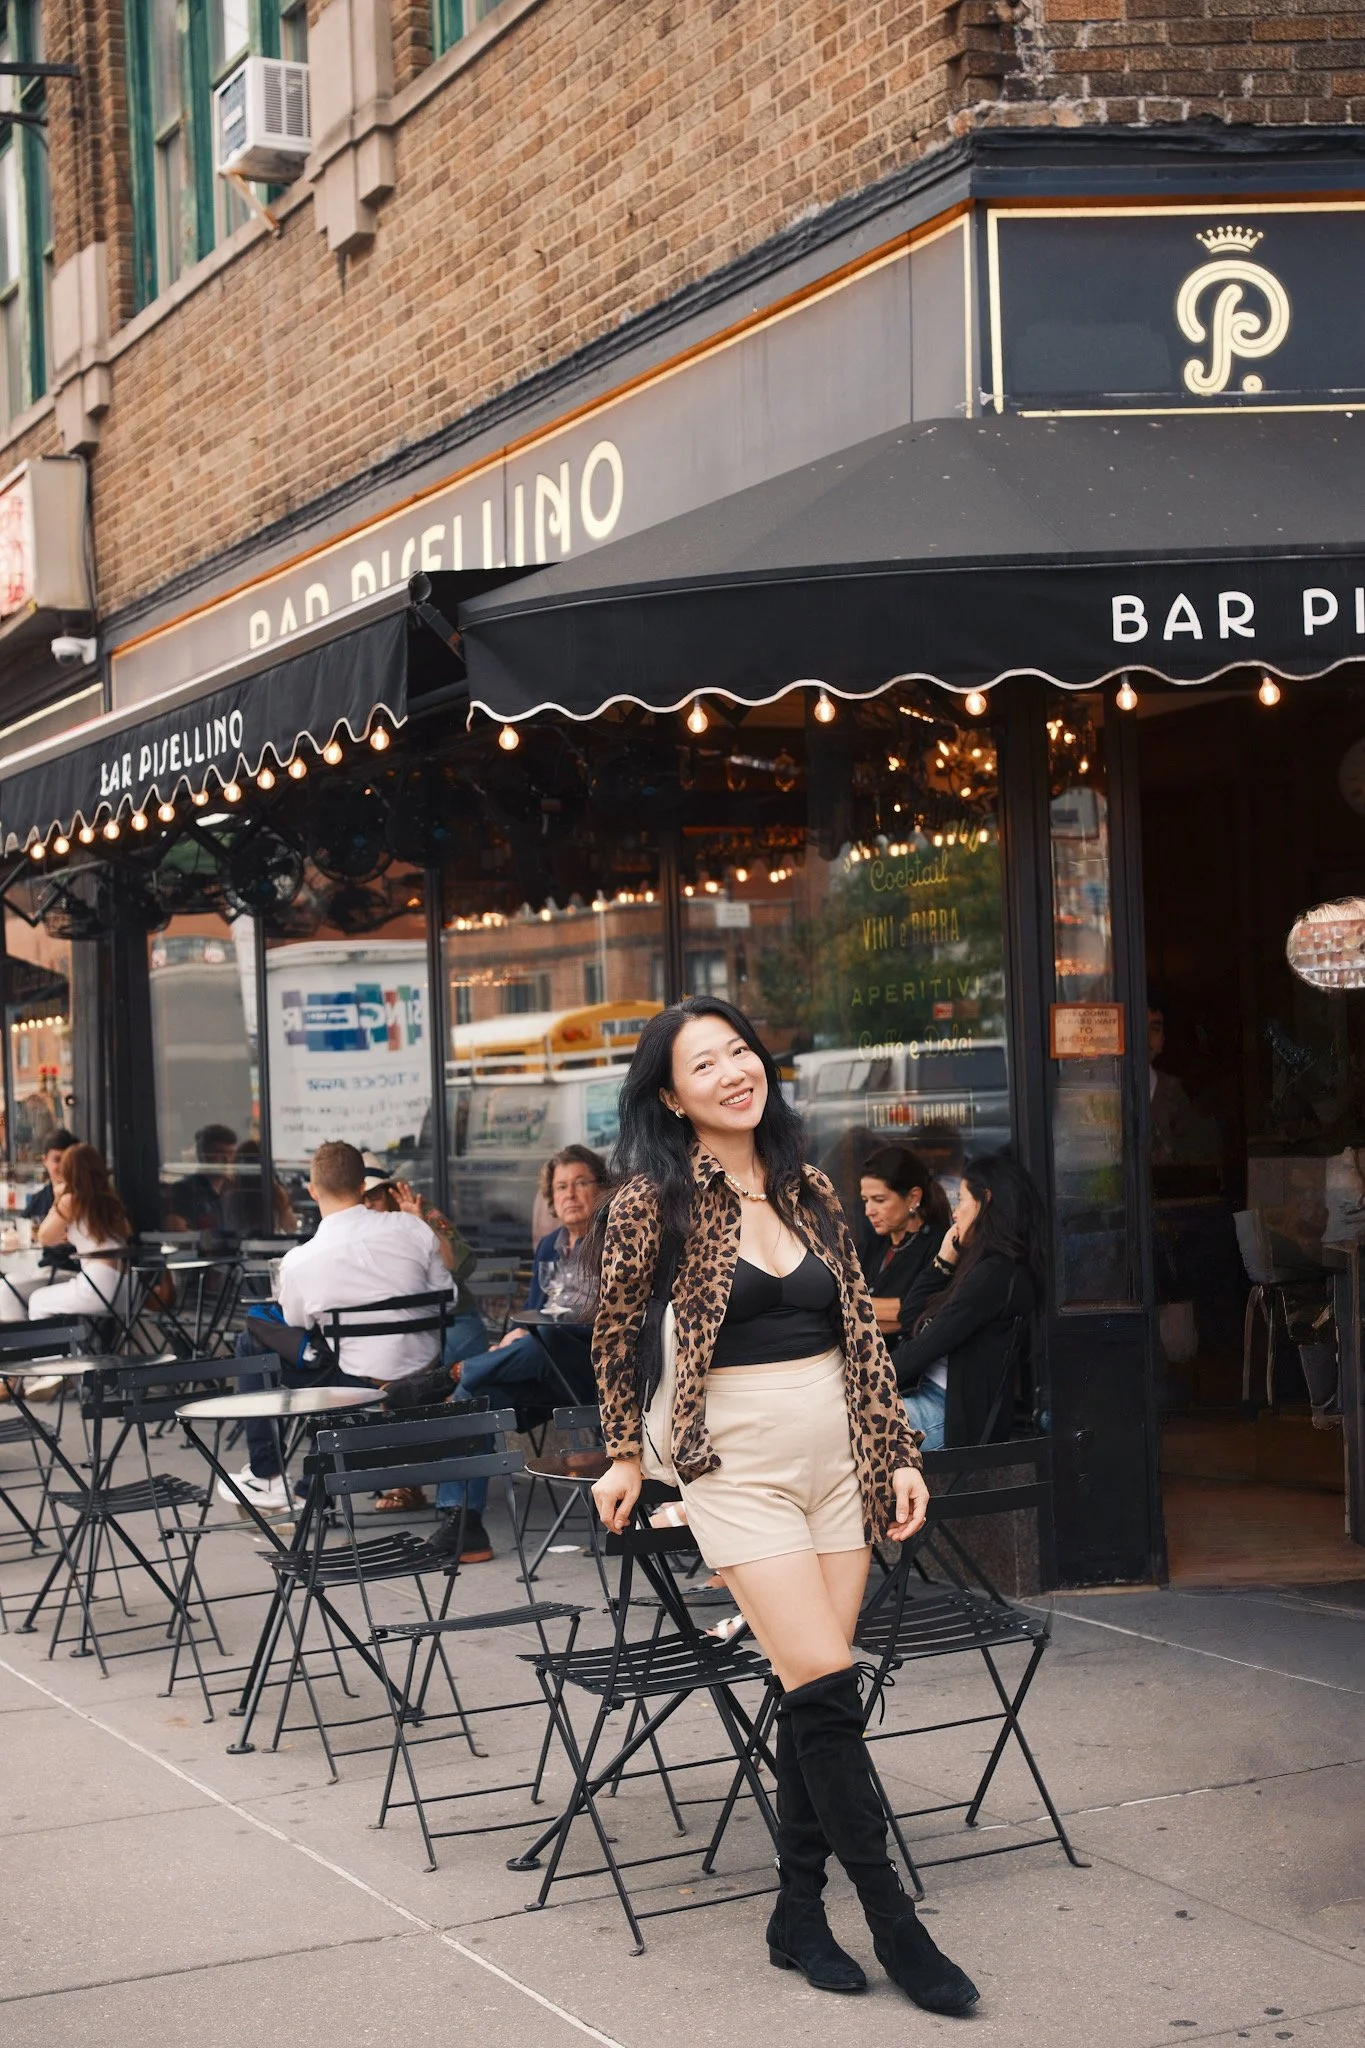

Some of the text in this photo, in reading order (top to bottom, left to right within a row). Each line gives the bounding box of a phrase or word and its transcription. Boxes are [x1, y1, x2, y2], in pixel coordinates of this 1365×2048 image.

[1112, 586, 1365, 643] BAR PI
[138, 709, 243, 782] PISELLINO
[870, 849, 949, 892] Cocktail
[862, 915, 894, 951] VINI
[851, 975, 981, 1006] APERITIVI
